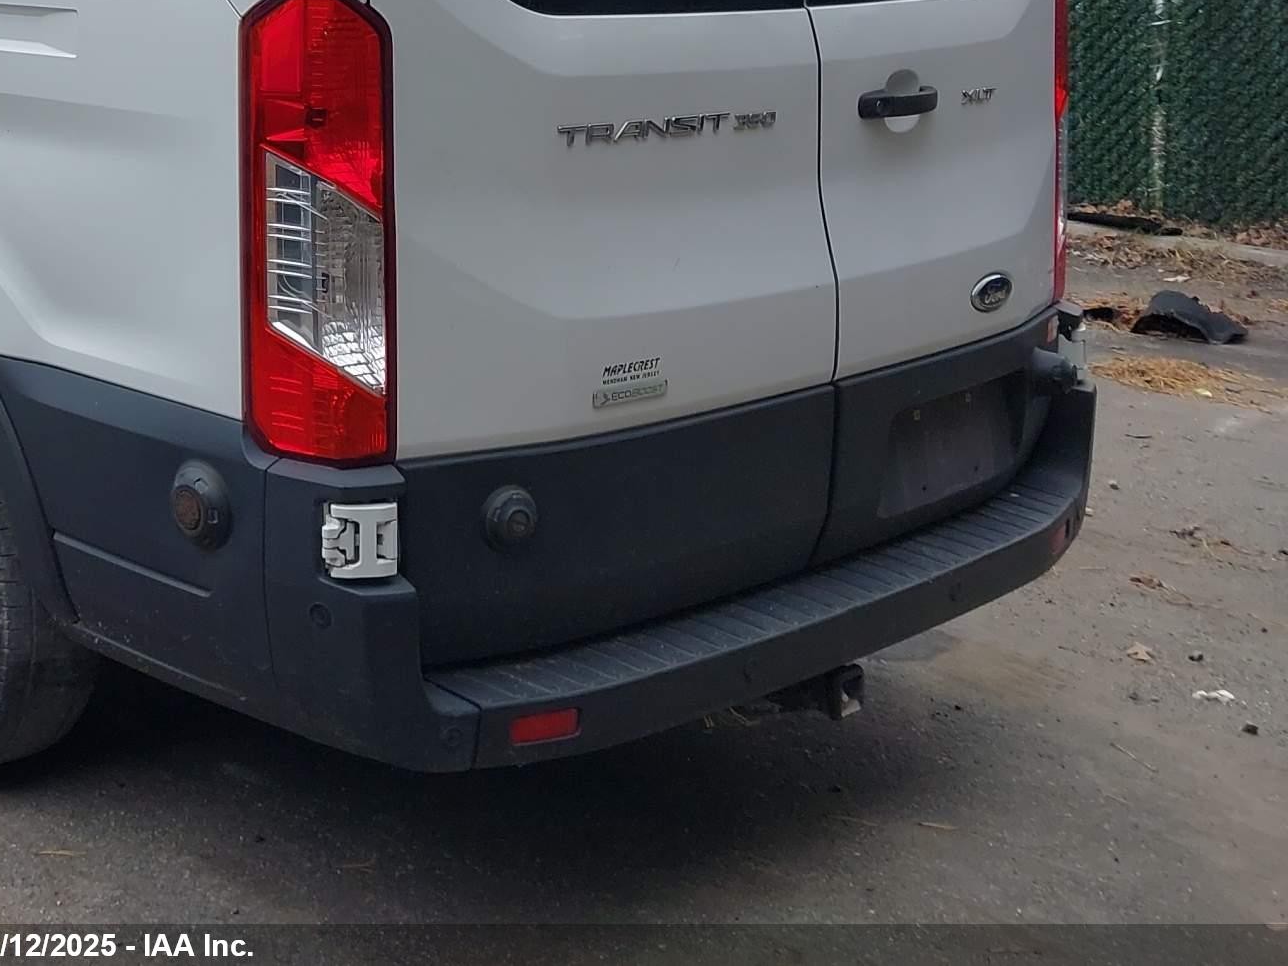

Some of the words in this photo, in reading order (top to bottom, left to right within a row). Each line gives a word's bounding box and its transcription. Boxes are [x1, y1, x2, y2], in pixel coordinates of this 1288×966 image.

[960, 86, 997, 104] XLT
[557, 112, 731, 147] TRANSIT
[734, 111, 777, 131] 350
[602, 357, 661, 377] MAPLECREST
[642, 370, 660, 378] JERSEY
